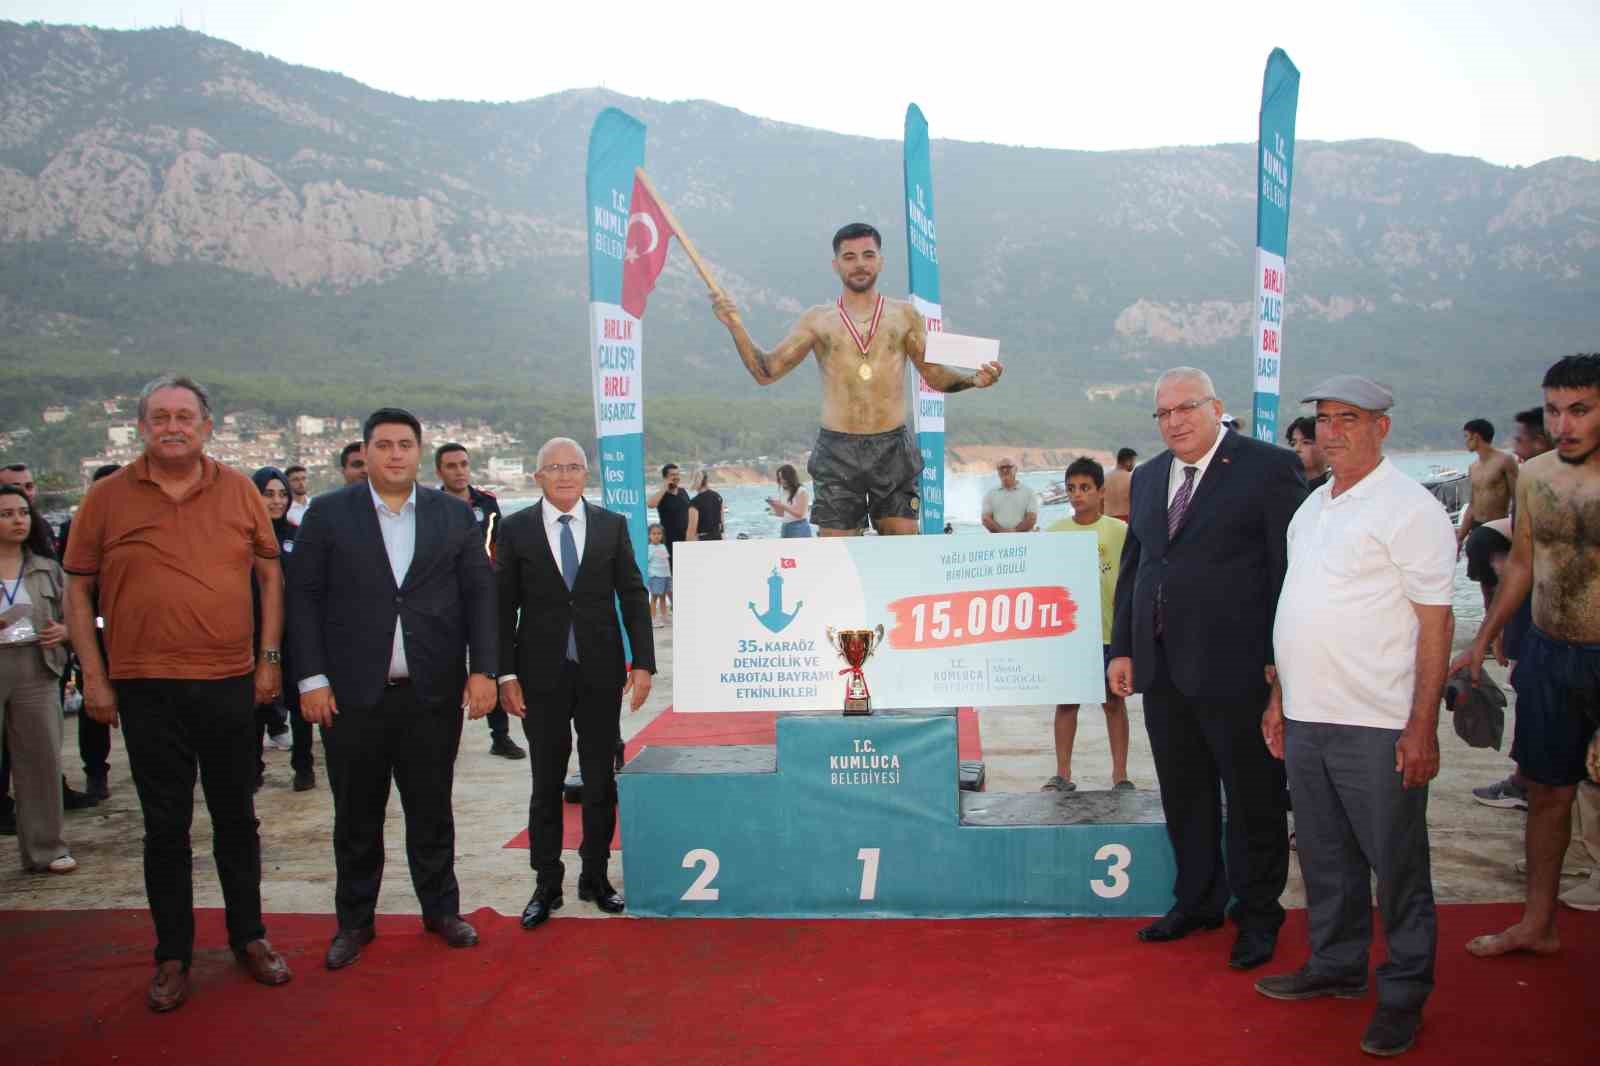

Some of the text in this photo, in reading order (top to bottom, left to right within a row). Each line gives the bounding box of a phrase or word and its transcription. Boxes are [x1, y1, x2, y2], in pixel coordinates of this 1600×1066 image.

[737, 637, 817, 653] 35. KARAÖZ
[733, 656, 821, 669] DENİZCİLİK VE
[720, 669, 834, 684] KABOTAJ BAYRAMI
[735, 686, 818, 699] ETKİNLİKLERİ
[854, 739, 877, 753] T.C.
[830, 754, 900, 769] KUMLUCA
[831, 769, 900, 785] BELEDİYESİ
[680, 848, 720, 900] 2
[857, 848, 880, 900] 1
[1090, 844, 1132, 898] 3
